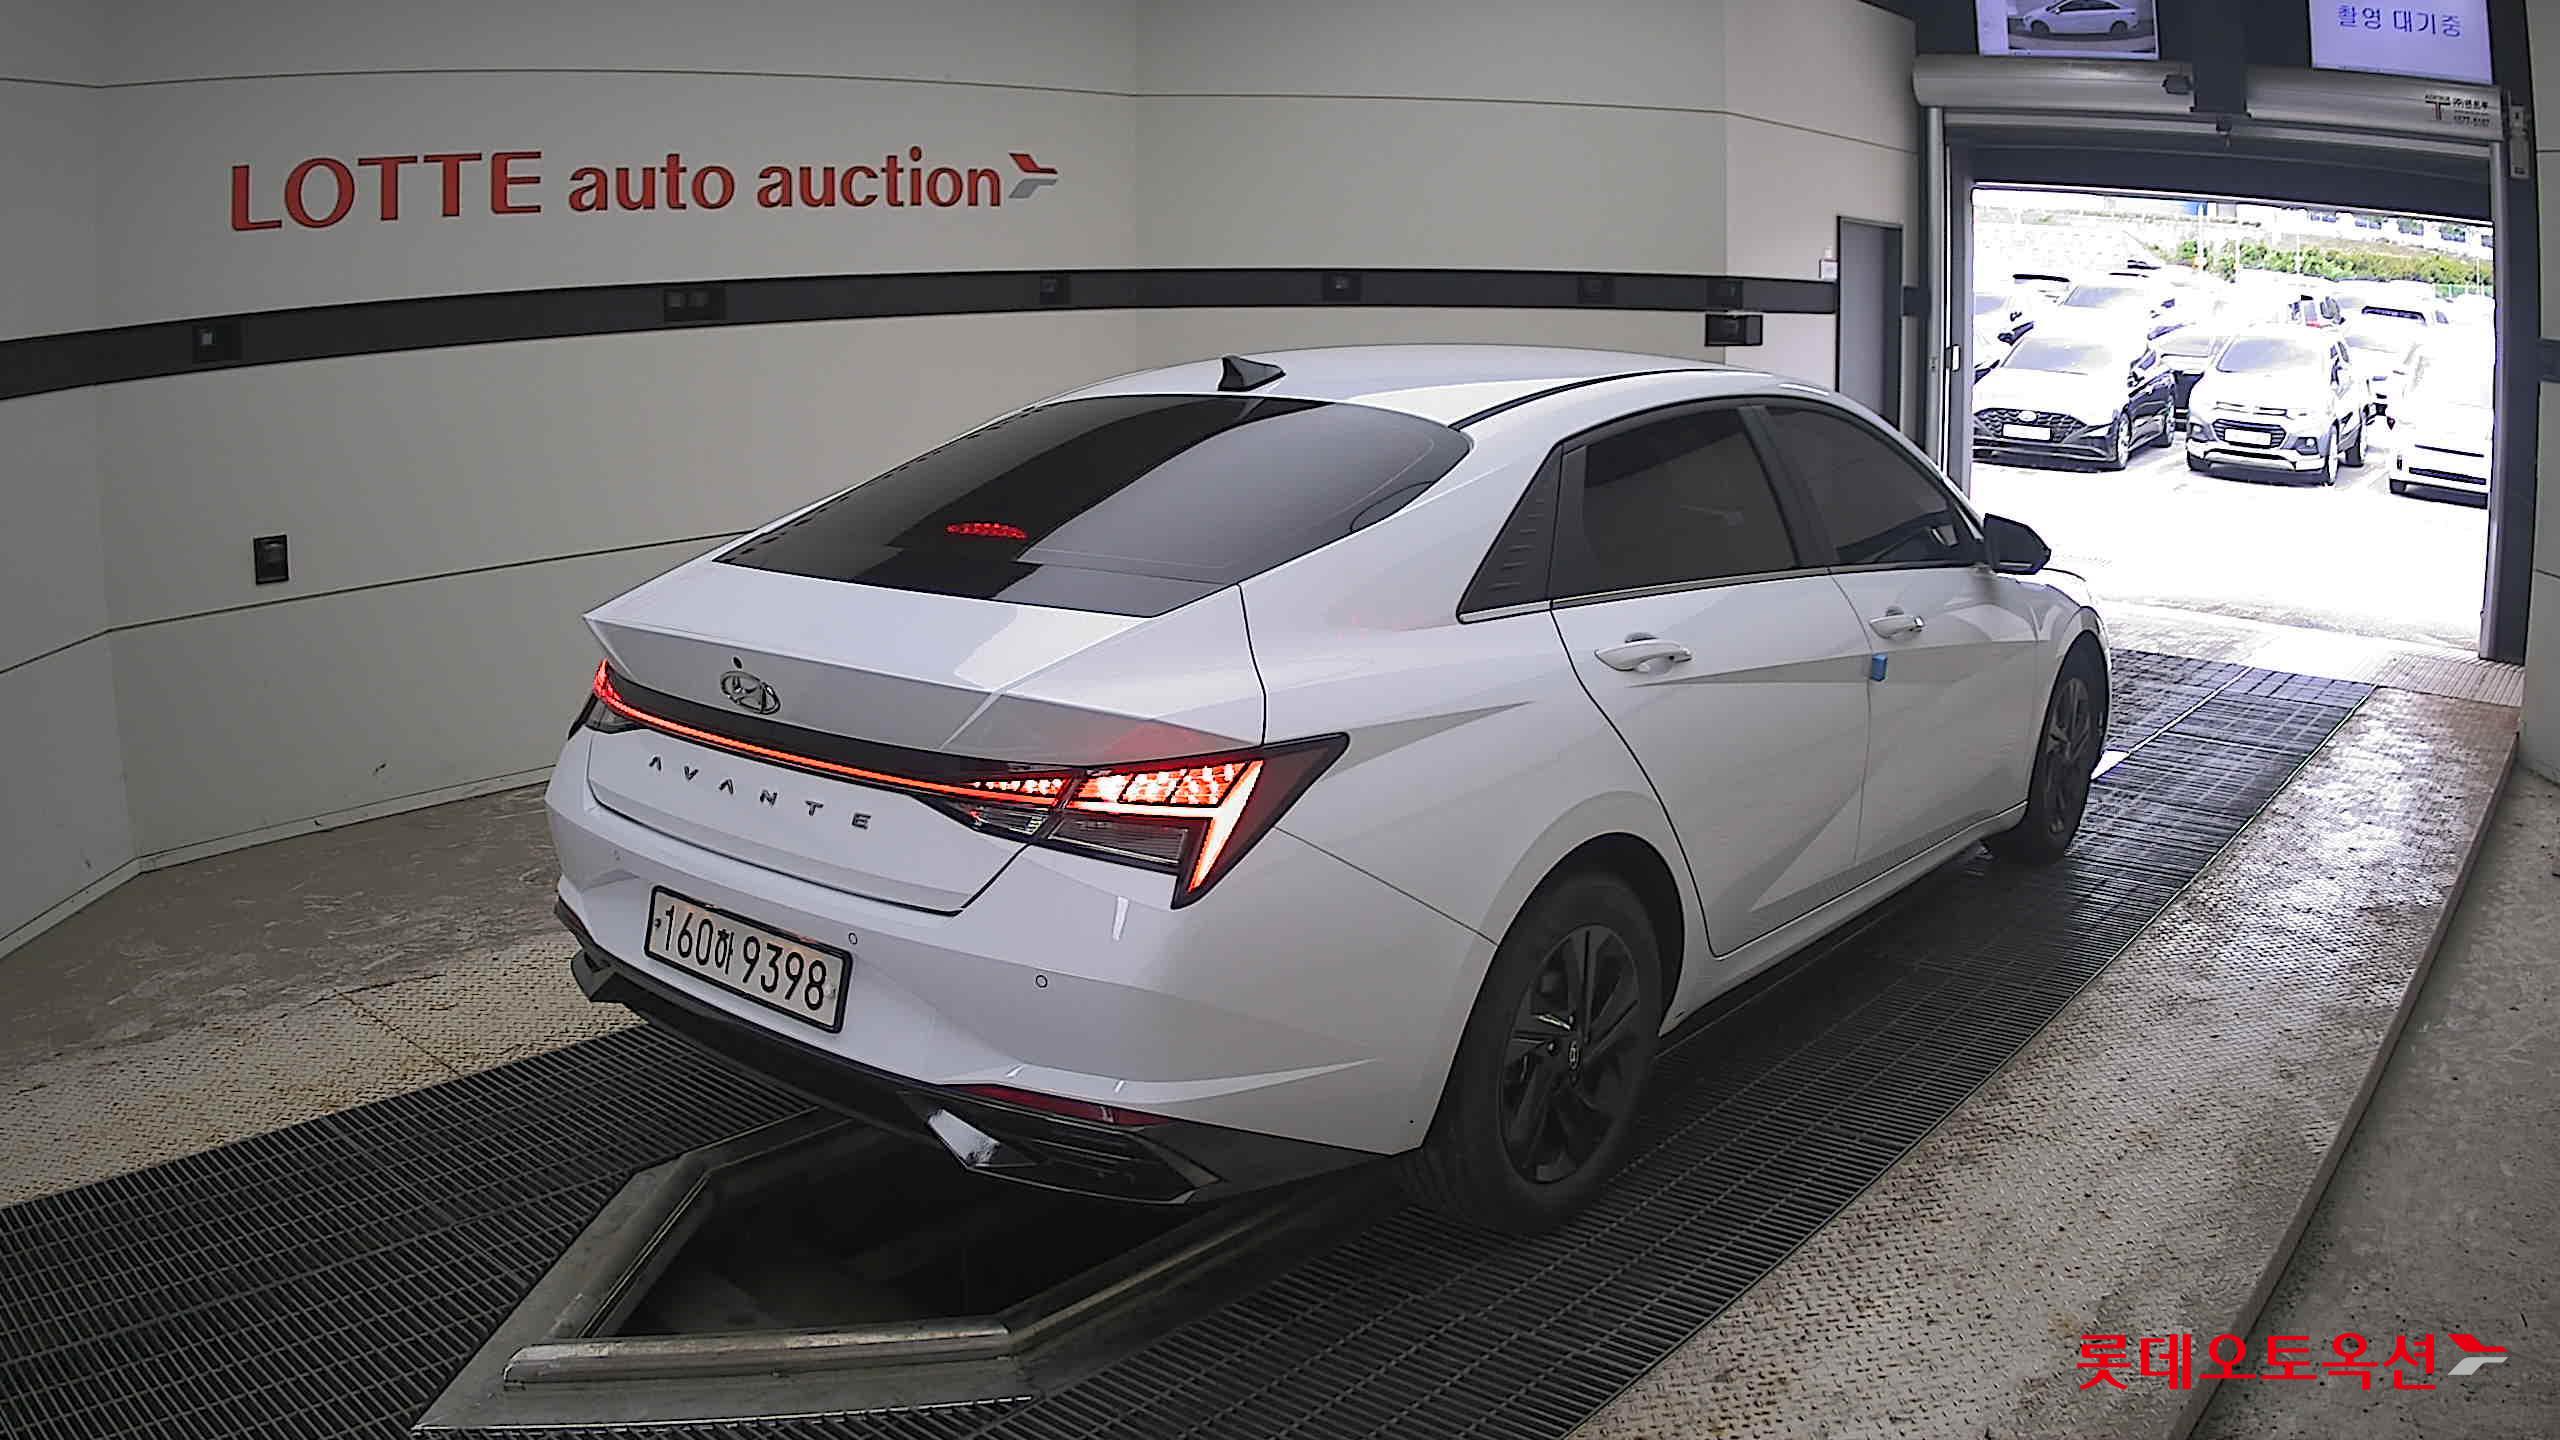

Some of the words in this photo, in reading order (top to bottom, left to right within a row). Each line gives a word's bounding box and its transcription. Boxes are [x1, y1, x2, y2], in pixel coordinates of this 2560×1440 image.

[2338, 5, 2382, 30] 촬영
[2393, 10, 2462, 38] 대기중
[232, 151, 541, 231] LOTTE
[569, 153, 735, 210] auto
[757, 147, 1000, 207] auction
[648, 756, 872, 829] AVANTE
